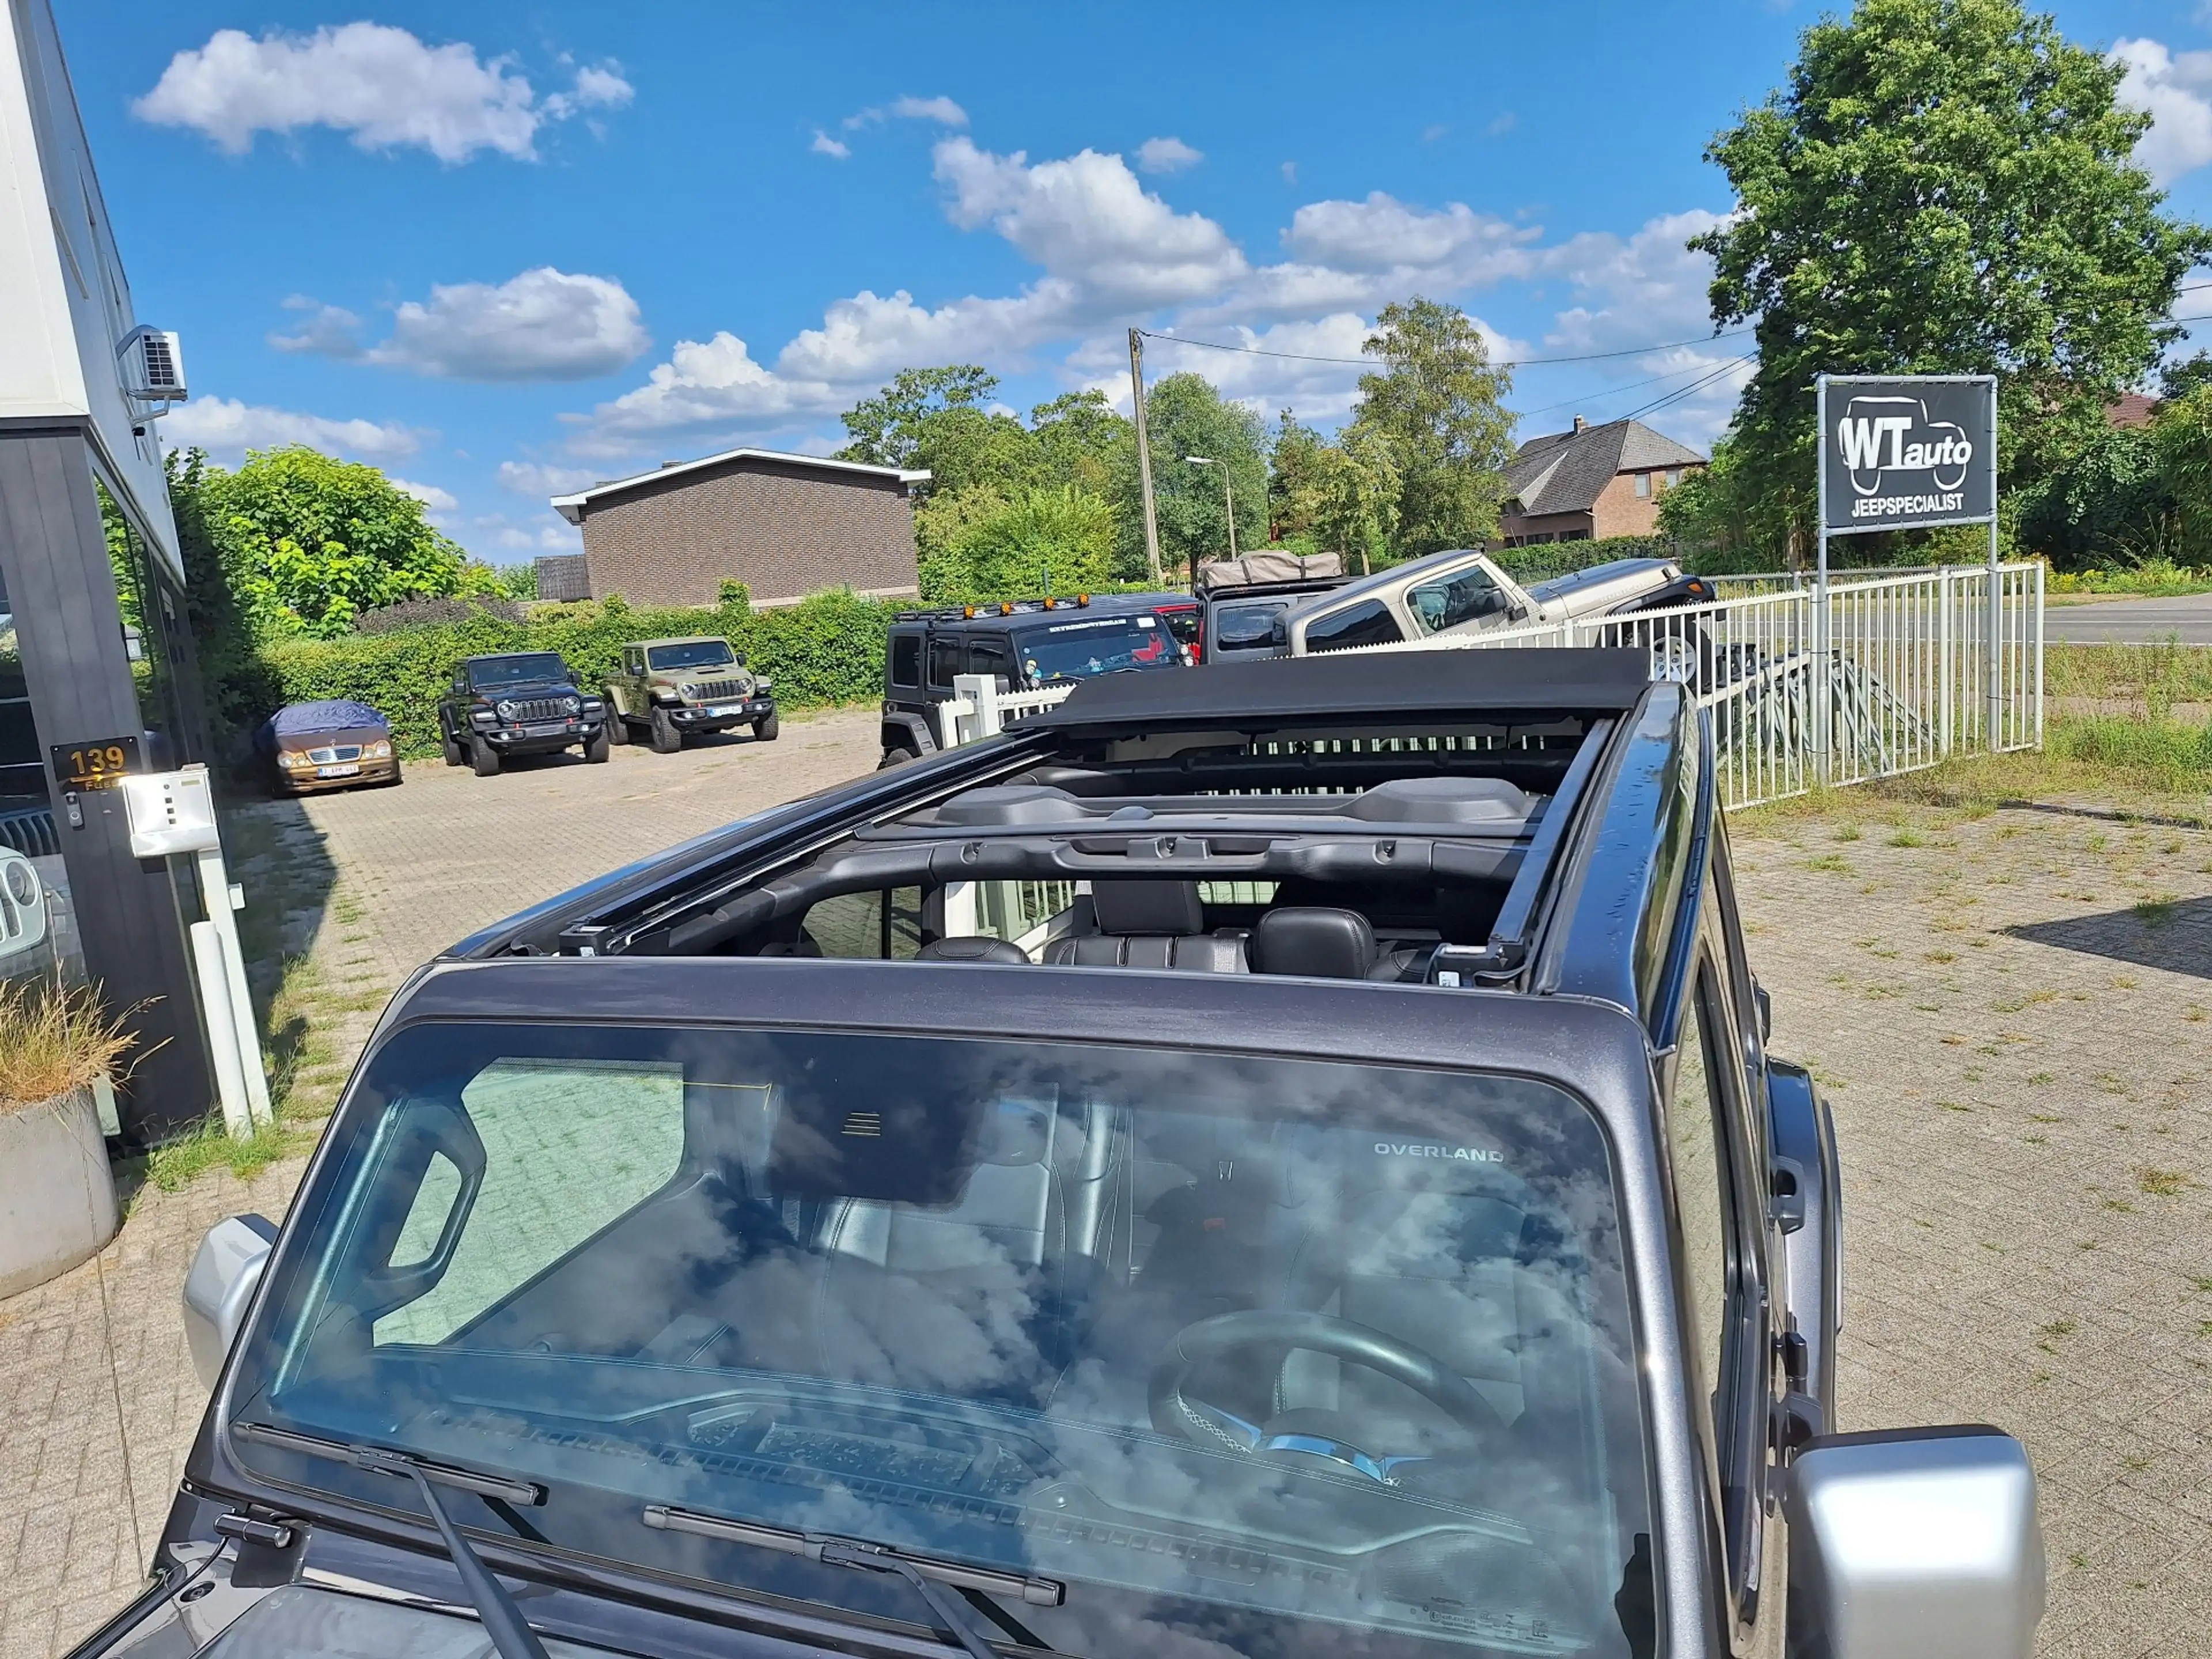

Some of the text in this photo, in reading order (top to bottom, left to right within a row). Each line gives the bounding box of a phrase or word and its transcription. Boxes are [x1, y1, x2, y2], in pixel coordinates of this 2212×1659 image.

[1851, 493, 1964, 518] JEEPSPECIALIST
[70, 745, 124, 774] 139
[1374, 1142, 1504, 1162] OVERLAND
